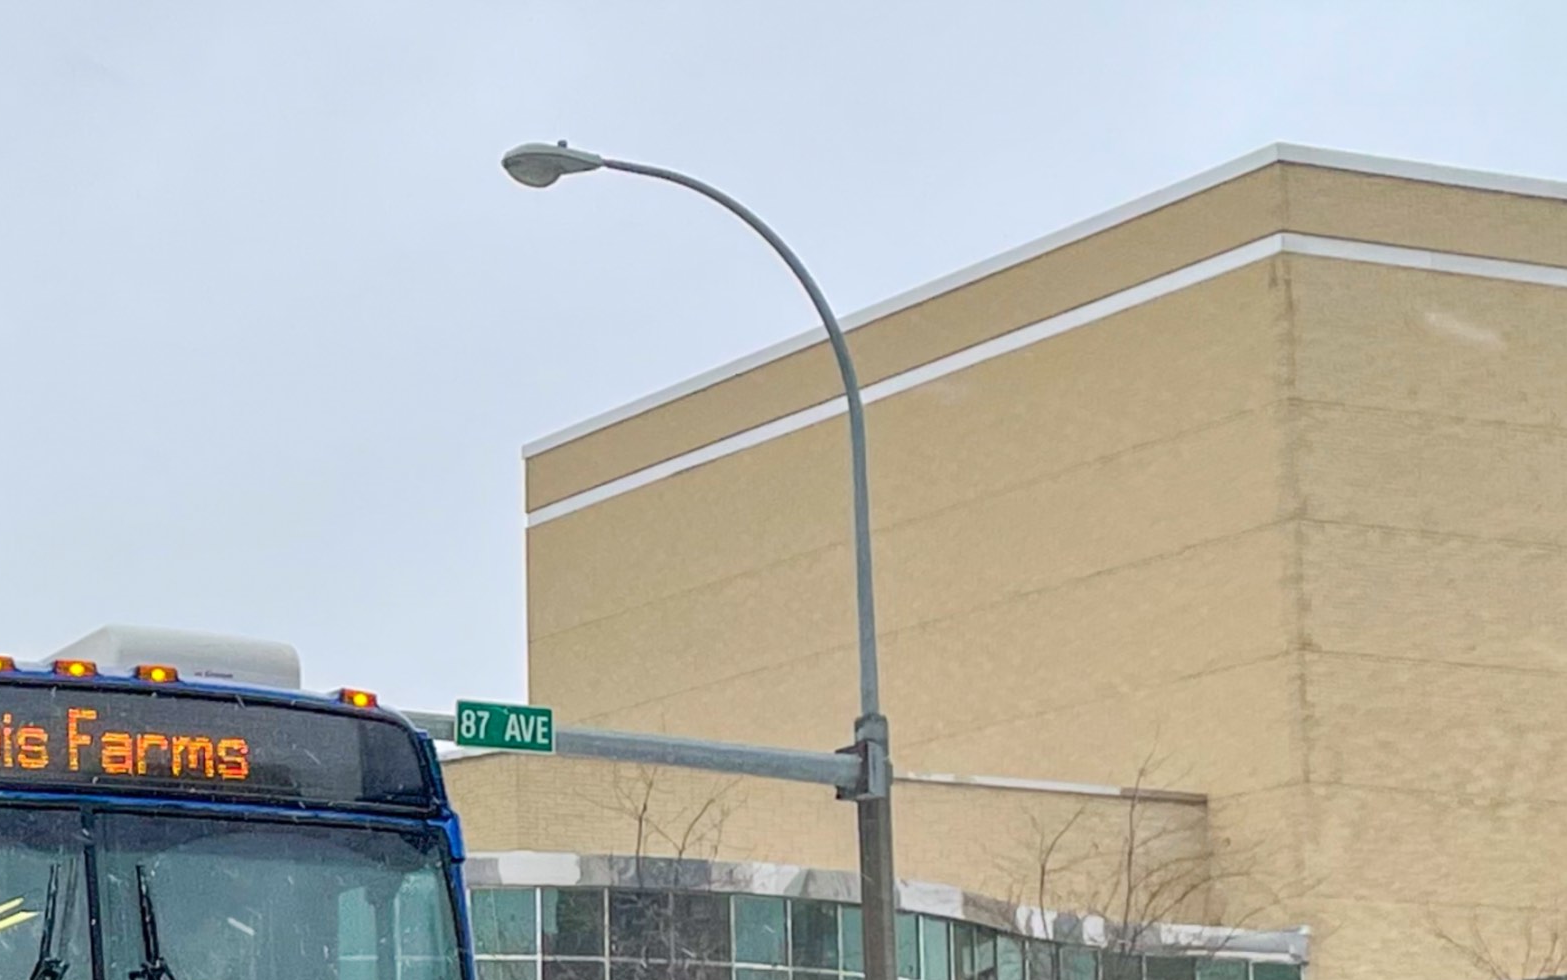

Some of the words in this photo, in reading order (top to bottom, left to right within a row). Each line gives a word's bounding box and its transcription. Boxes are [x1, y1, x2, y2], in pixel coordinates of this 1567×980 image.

[67, 707, 250, 780] Farms
[460, 709, 491, 739] 87
[504, 713, 550, 745] AVE
